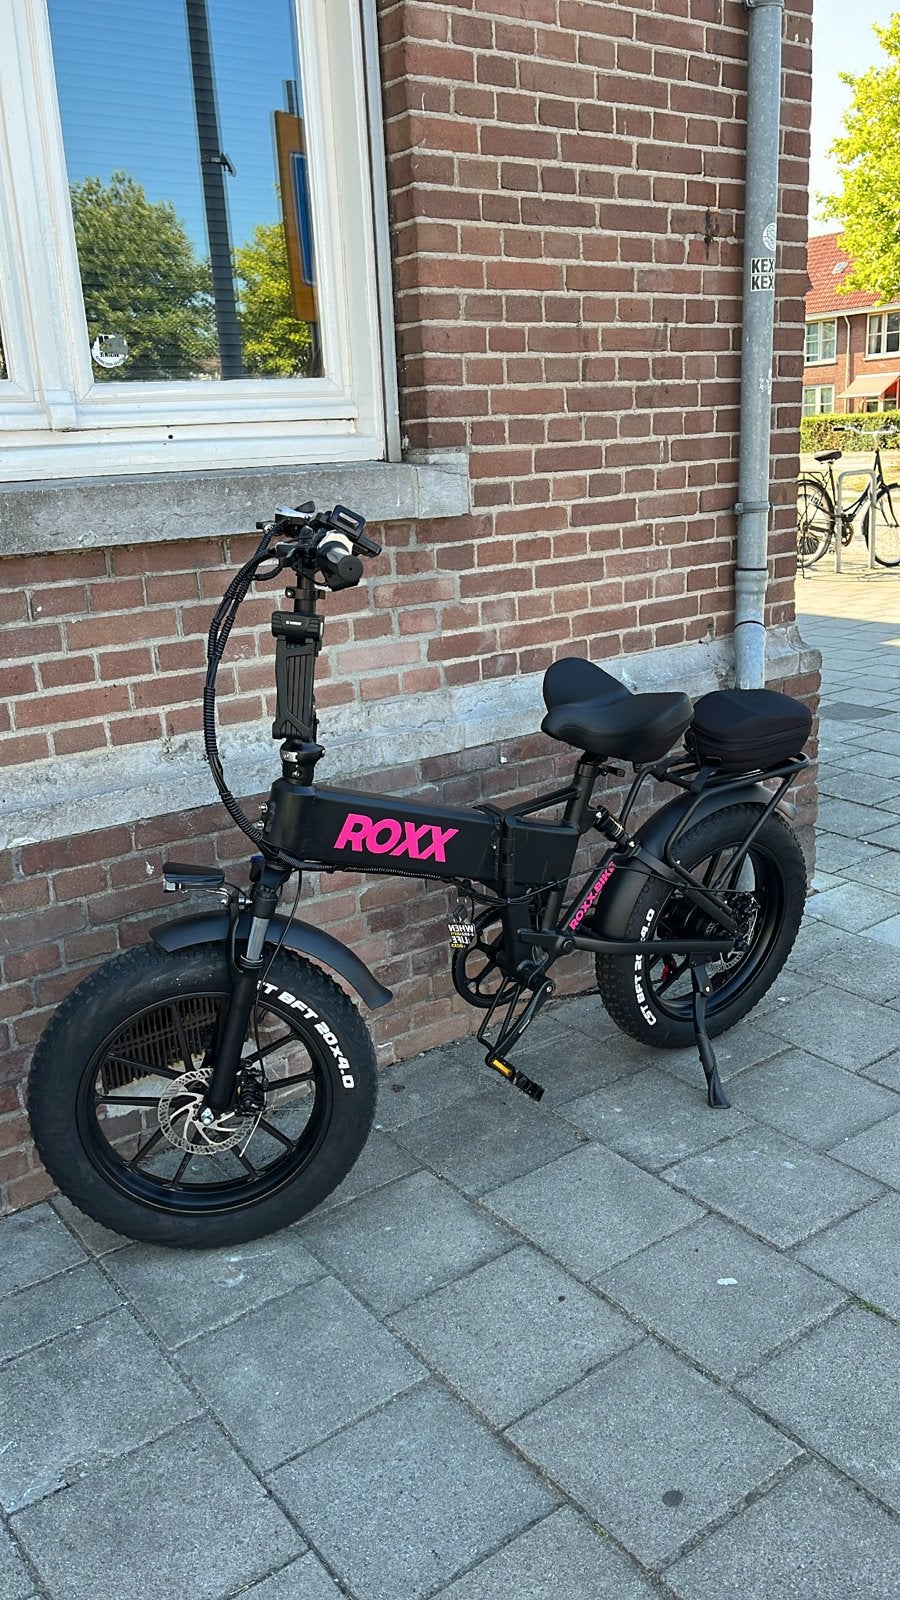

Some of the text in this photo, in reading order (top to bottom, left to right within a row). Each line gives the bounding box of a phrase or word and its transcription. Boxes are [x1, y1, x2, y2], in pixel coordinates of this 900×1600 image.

[752, 259, 775, 273] KEX
[752, 276, 774, 290] KEX
[334, 813, 459, 863] ROXX
[634, 975, 646, 1004] BFT
[277, 991, 319, 1019] BFT
[640, 1005, 657, 1026] CST
